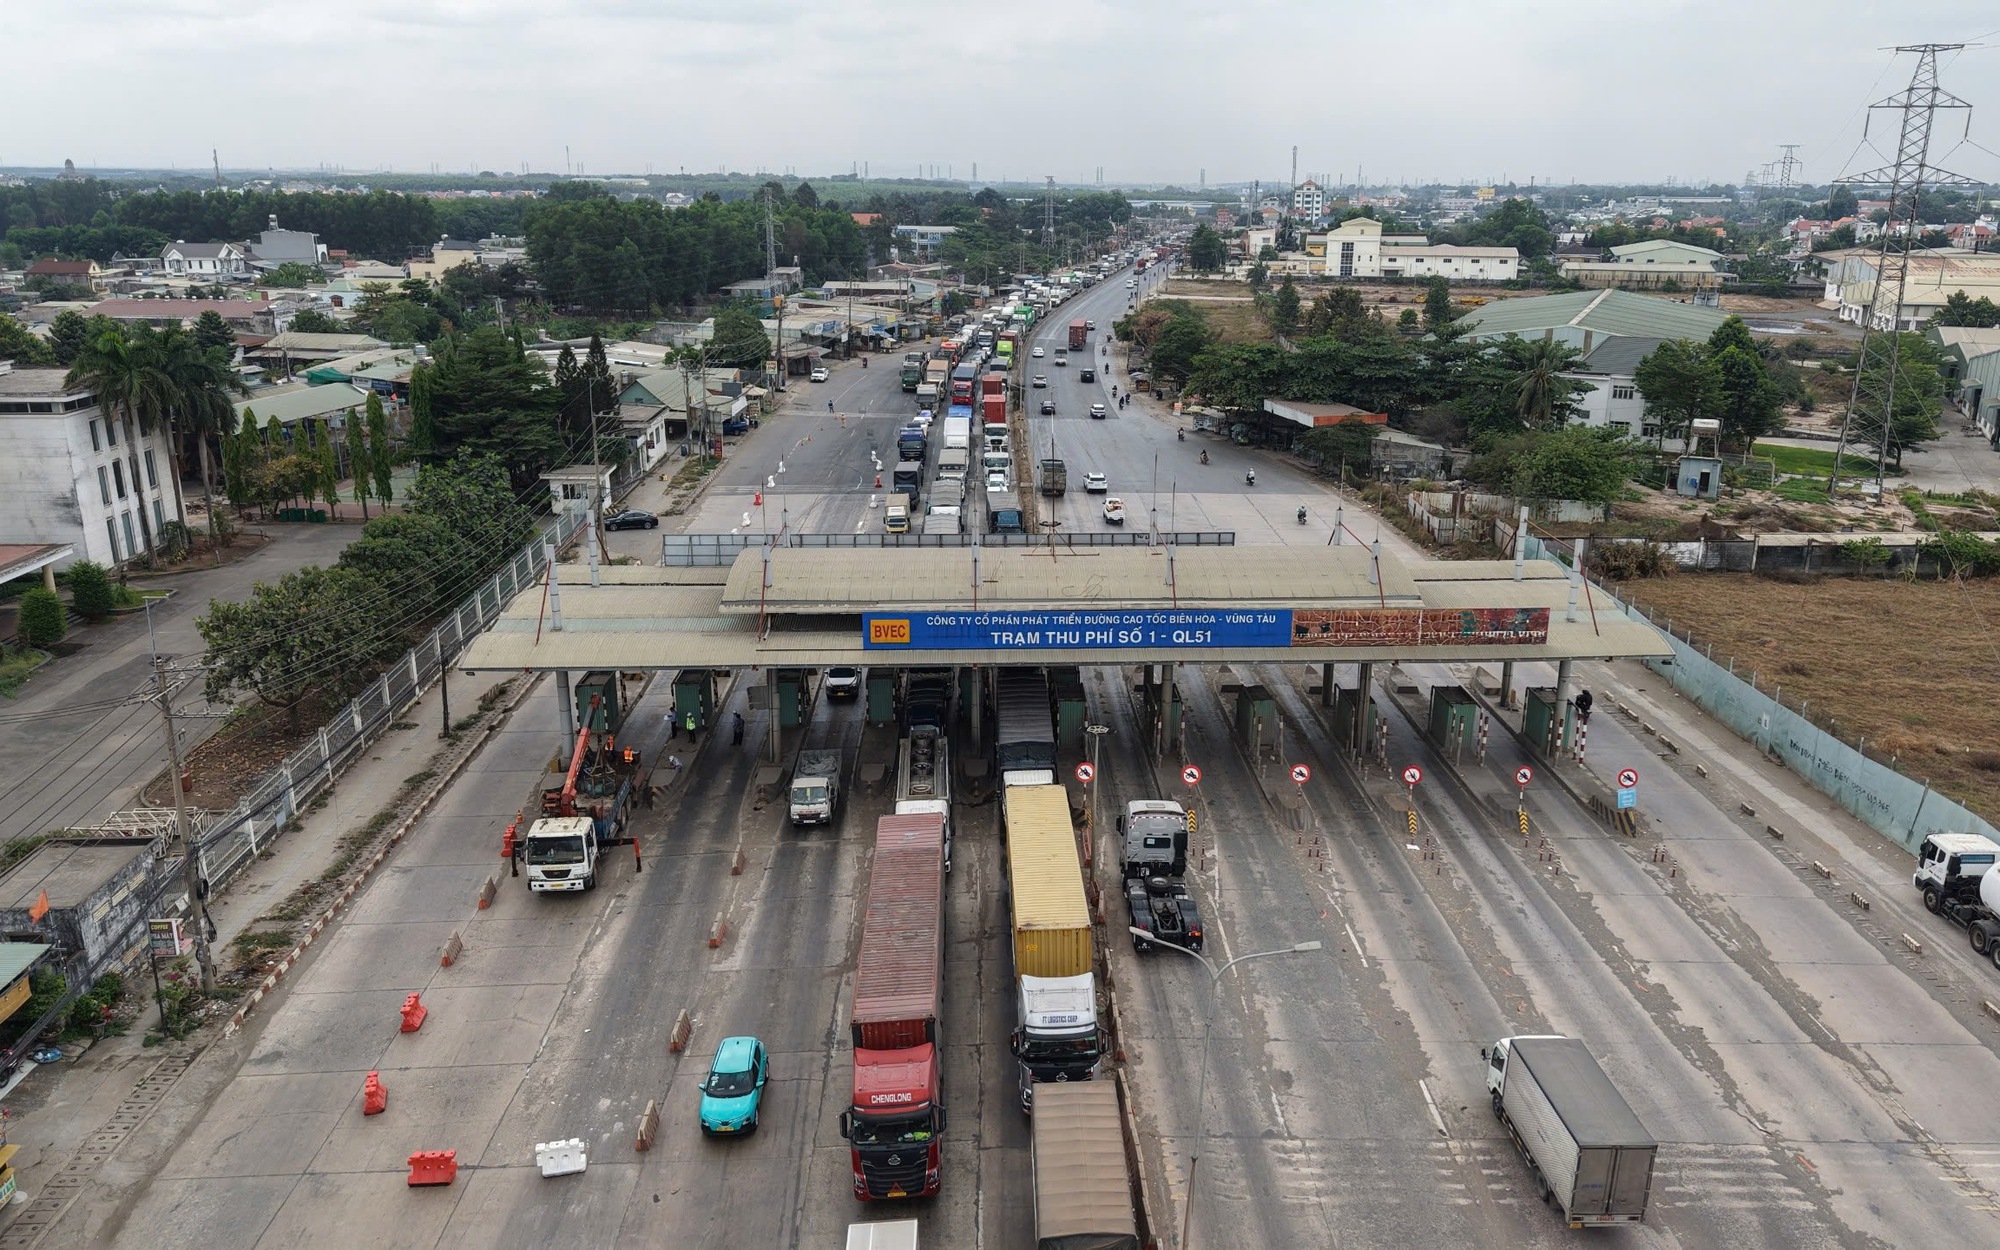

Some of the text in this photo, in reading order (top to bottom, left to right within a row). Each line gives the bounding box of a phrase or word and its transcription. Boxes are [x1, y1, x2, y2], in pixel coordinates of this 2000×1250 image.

[926, 615, 956, 625] CÔNG
[959, 616, 972, 625] TY
[974, 613, 990, 625] CỔ
[1022, 614, 1049, 625] PHÁT
[1052, 612, 1082, 625] TRIỂN
[1084, 613, 1120, 624] ĐƯỜNG
[1123, 615, 1144, 624] CAO
[1146, 612, 1167, 624] TỐC
[1169, 613, 1193, 624] BIÊN
[1195, 612, 1216, 624] HÒA
[1225, 612, 1254, 624] VŨNG
[1256, 612, 1276, 624] TÀU
[874, 625, 906, 638] BVEC
[990, 631, 1040, 646] TRẠM
[1045, 631, 1080, 644] THU
[1085, 627, 1113, 644] PHÍ
[1118, 626, 1142, 643] SỐ
[1149, 630, 1155, 643] 1
[1172, 630, 1211, 643] QL51
[1047, 1015, 1067, 1024] LOGISTICS
[871, 1092, 912, 1104] CHENGLONG
